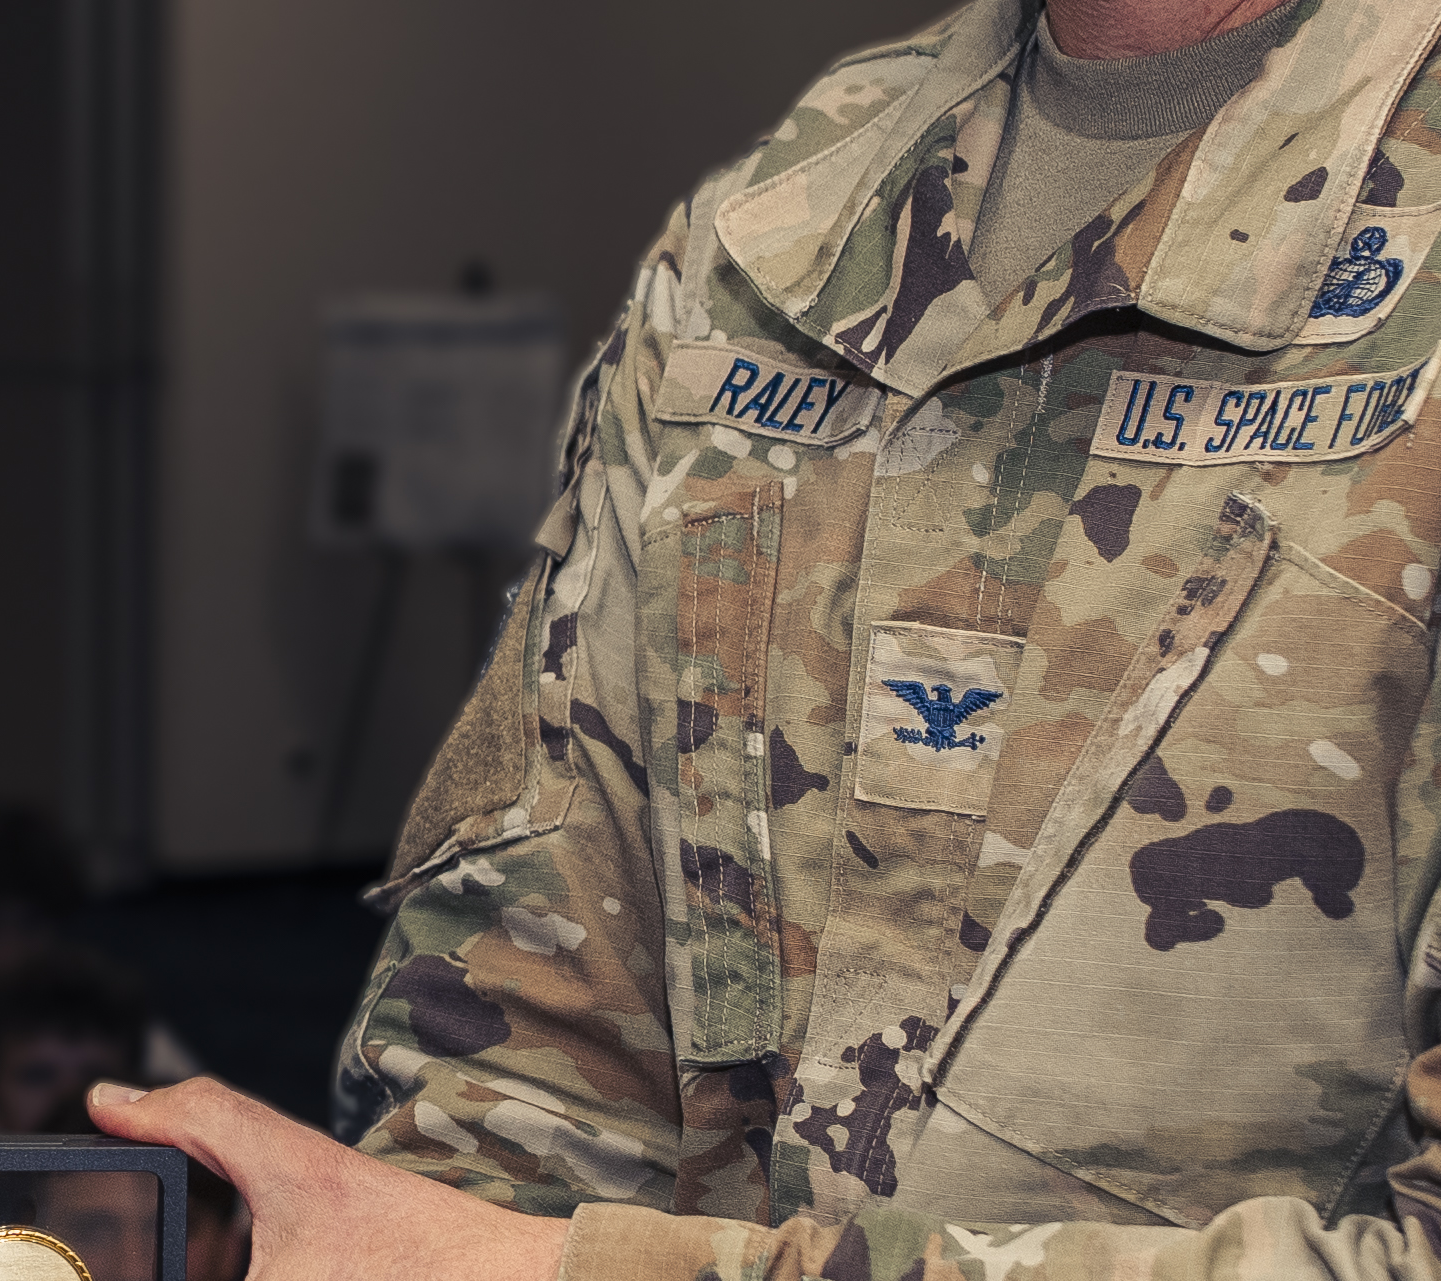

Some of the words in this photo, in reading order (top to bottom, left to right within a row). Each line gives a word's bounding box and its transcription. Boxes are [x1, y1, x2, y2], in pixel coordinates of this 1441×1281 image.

[709, 358, 852, 434] RALEY
[1116, 379, 1195, 451] U.S.
[1205, 385, 1332, 453] SPACE
